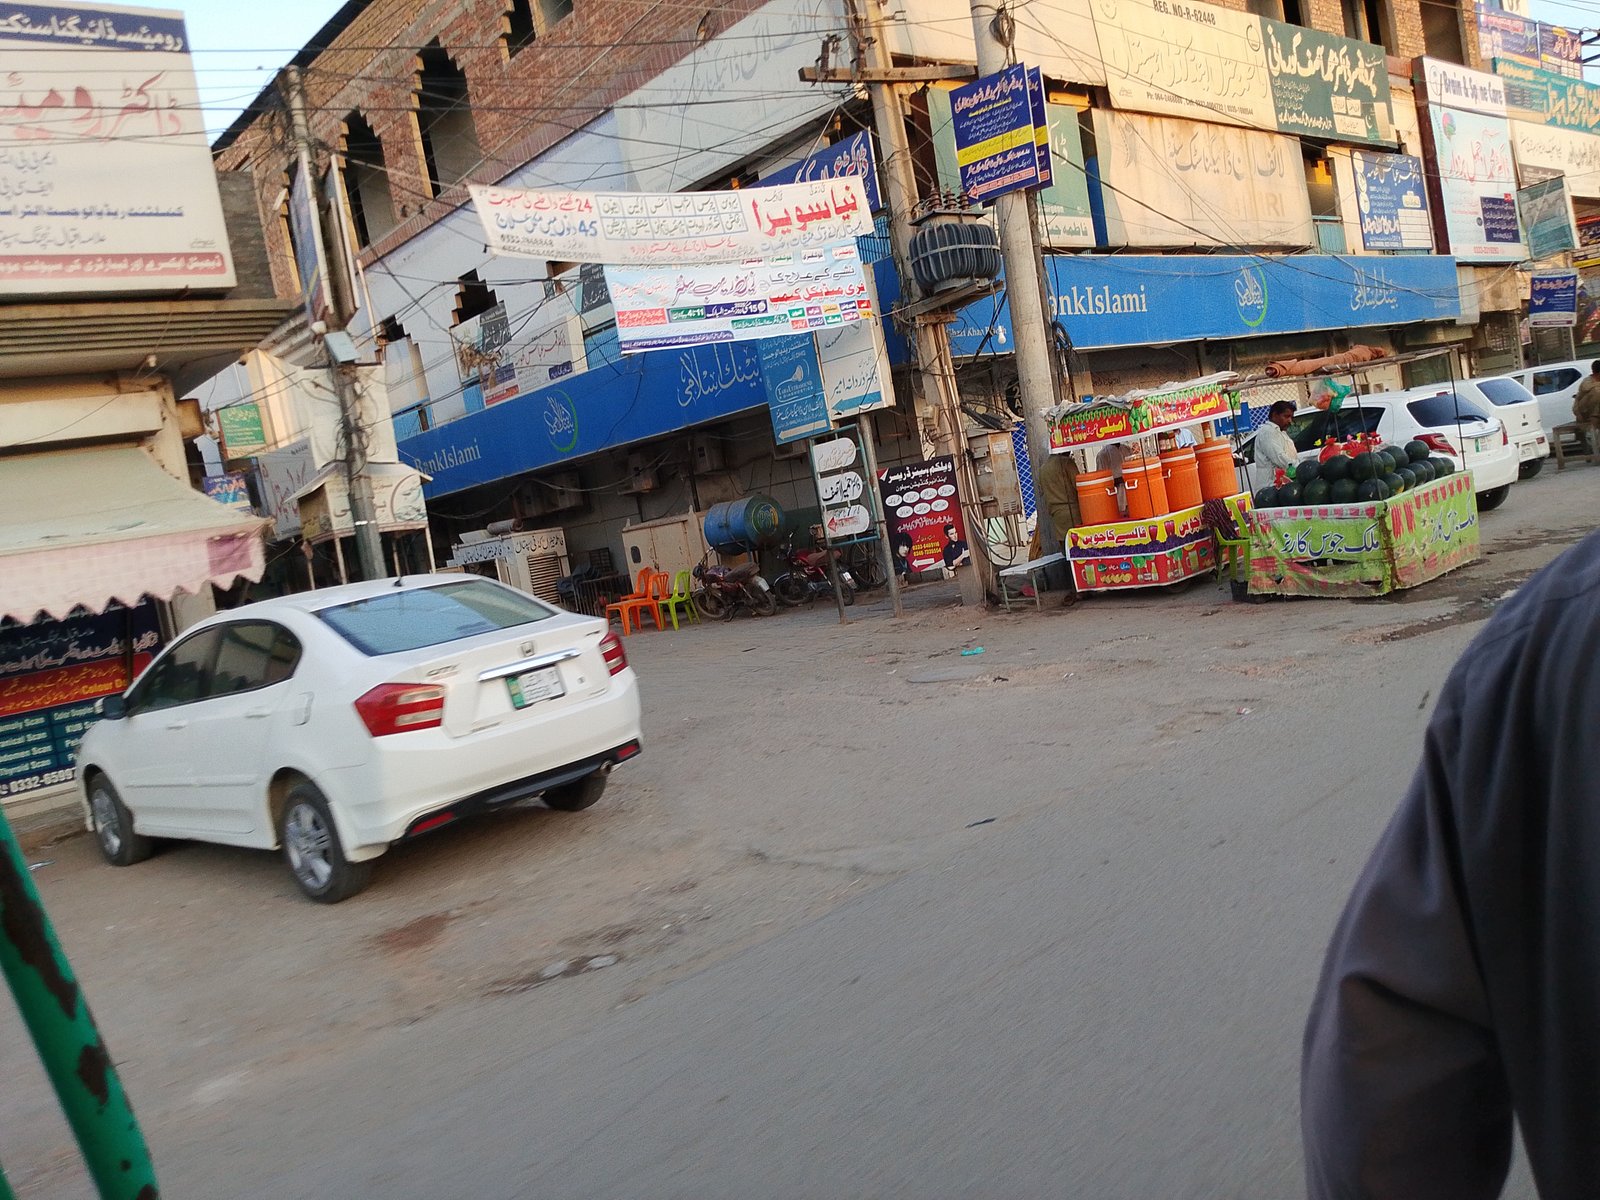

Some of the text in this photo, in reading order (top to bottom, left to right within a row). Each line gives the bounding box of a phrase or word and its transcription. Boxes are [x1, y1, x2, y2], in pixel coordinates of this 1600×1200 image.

[577, 198, 593, 213] 24
[578, 220, 598, 236] 45
[803, 284, 843, 301] میڈیکل
[845, 283, 866, 295] فری
[1047, 285, 1147, 316] ankIslami
[1115, 526, 1147, 544] فالسے
[1345, 522, 1380, 552] ملک
[1308, 530, 1344, 558] جوس
[82, 682, 113, 695] Colour
[24, 717, 45, 726] Scan
[26, 733, 47, 741] Scan
[31, 745, 52, 755] Scan
[30, 760, 51, 769] Scan
